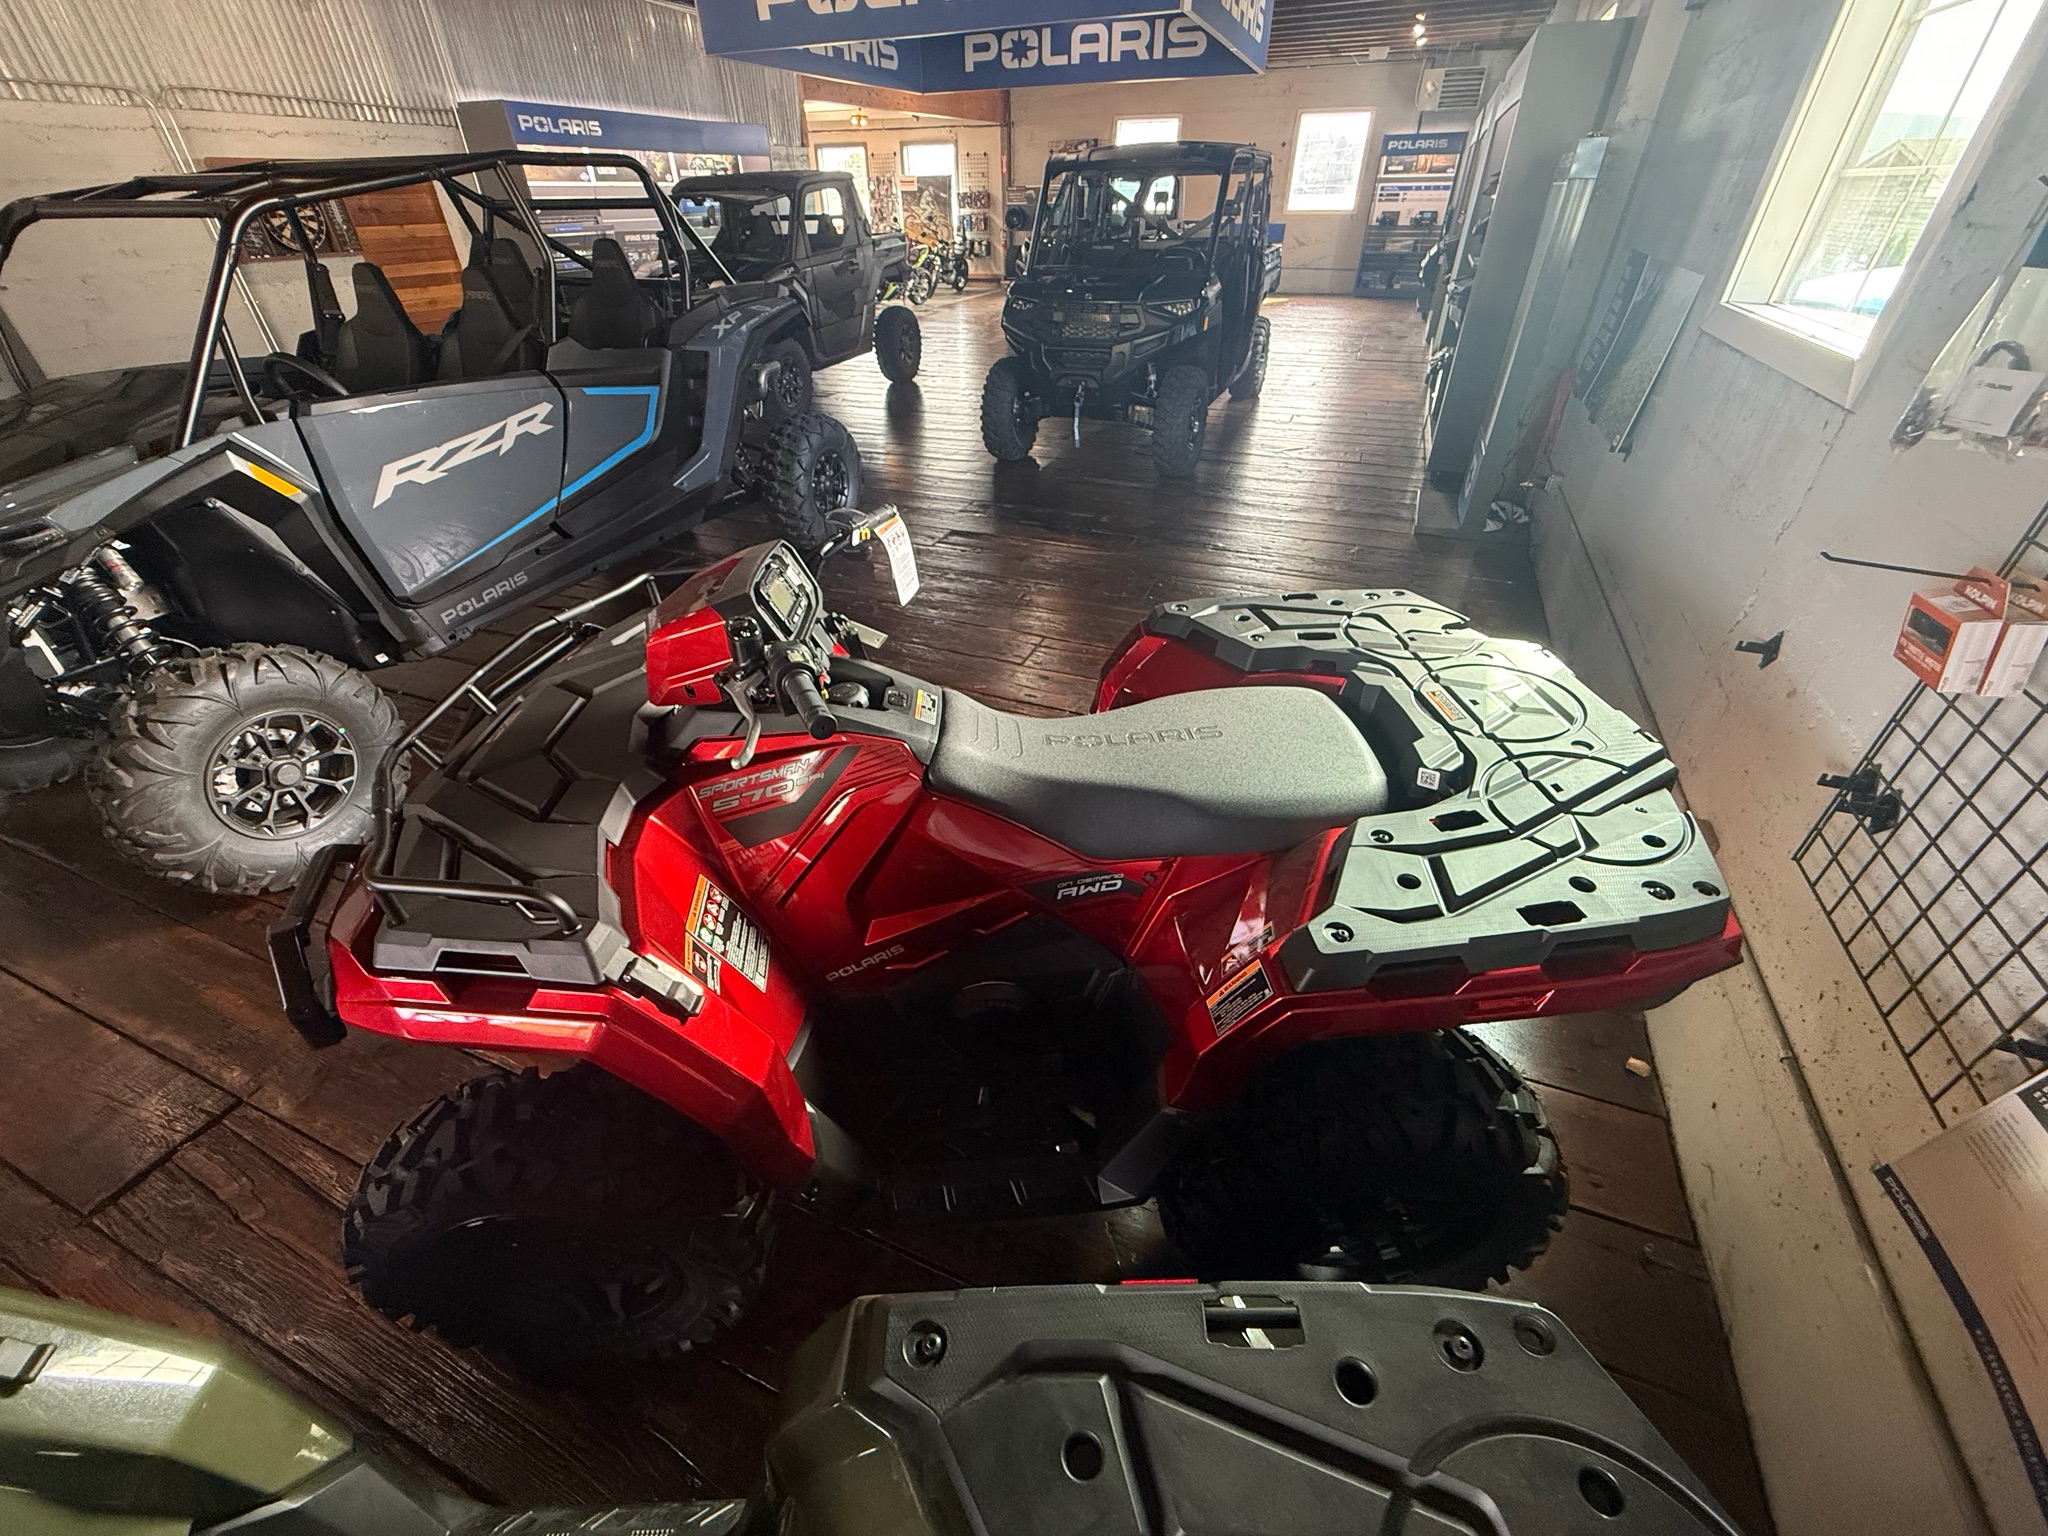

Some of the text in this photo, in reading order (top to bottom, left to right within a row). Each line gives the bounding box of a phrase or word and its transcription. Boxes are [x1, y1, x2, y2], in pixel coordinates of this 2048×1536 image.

[963, 17, 1208, 72] POLARIS
[517, 114, 603, 137] POLARIS
[1388, 138, 1449, 151] POLARIS
[373, 401, 555, 509] RZR
[440, 571, 528, 625] POLARIS
[1044, 725, 1223, 748] POLARIS
[699, 757, 813, 798] SPORTSMAN
[712, 778, 795, 813] 570
[1056, 879, 1122, 900] AWD
[1057, 873, 1124, 889] ON DEMAND
[825, 944, 905, 982] POLARIS
[1884, 1177, 1929, 1240] POLARIS
